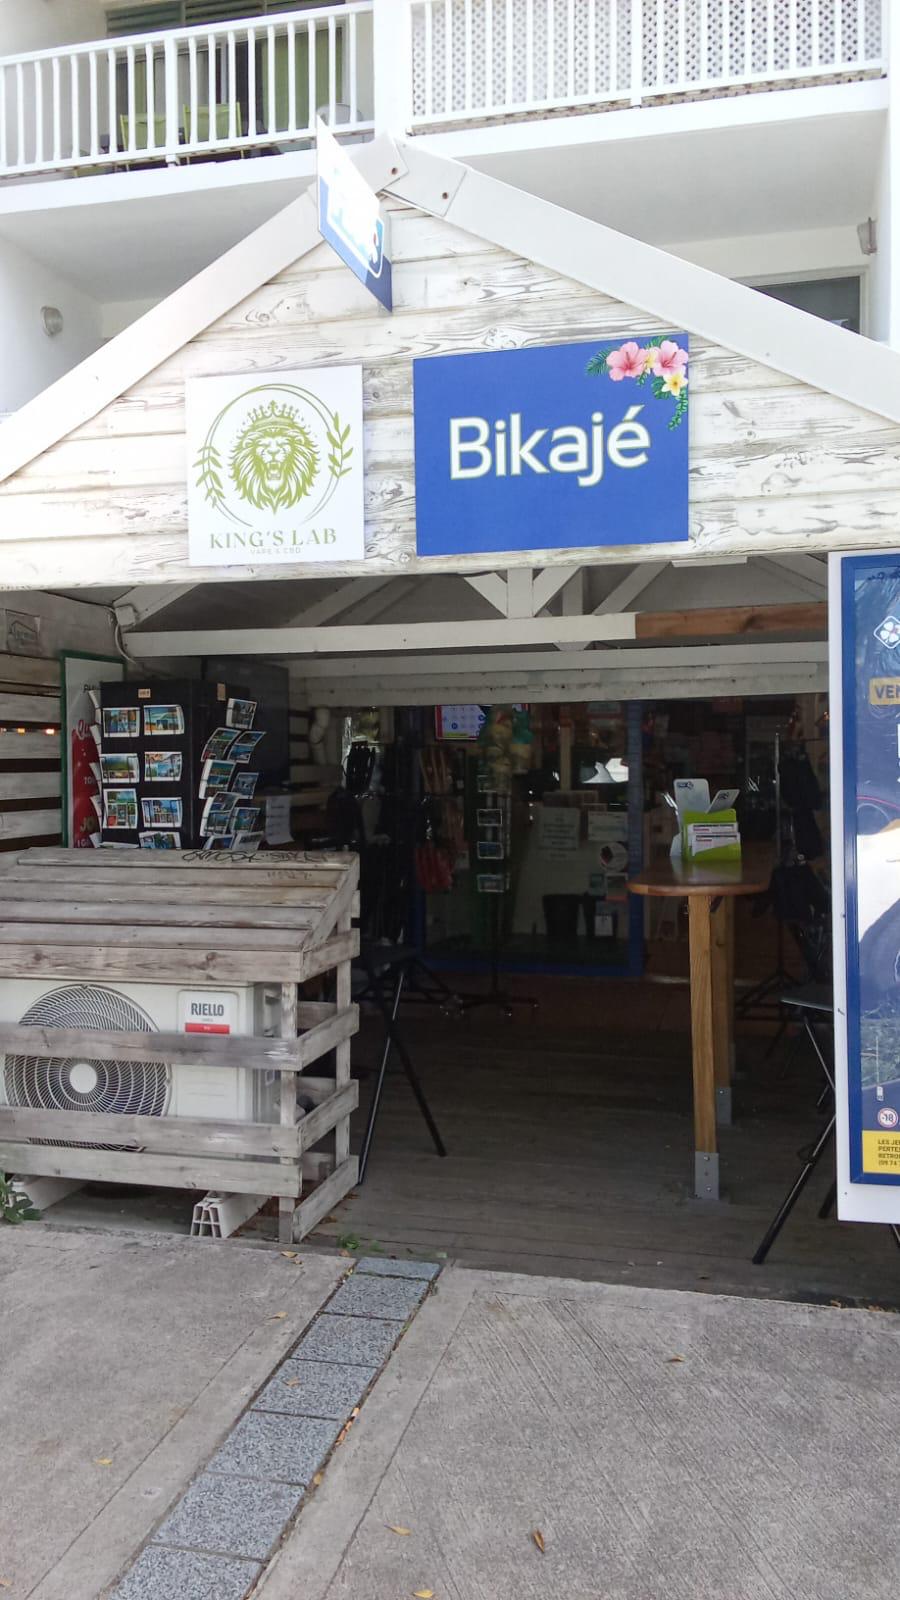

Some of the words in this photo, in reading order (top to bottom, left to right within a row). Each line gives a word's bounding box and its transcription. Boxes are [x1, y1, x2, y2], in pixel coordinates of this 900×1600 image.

[449, 404, 651, 487] Bikajé
[210, 530, 284, 549] KING'S
[292, 528, 337, 546] LAB
[283, 546, 301, 554] CBD
[191, 1002, 224, 1016] RIELLO
